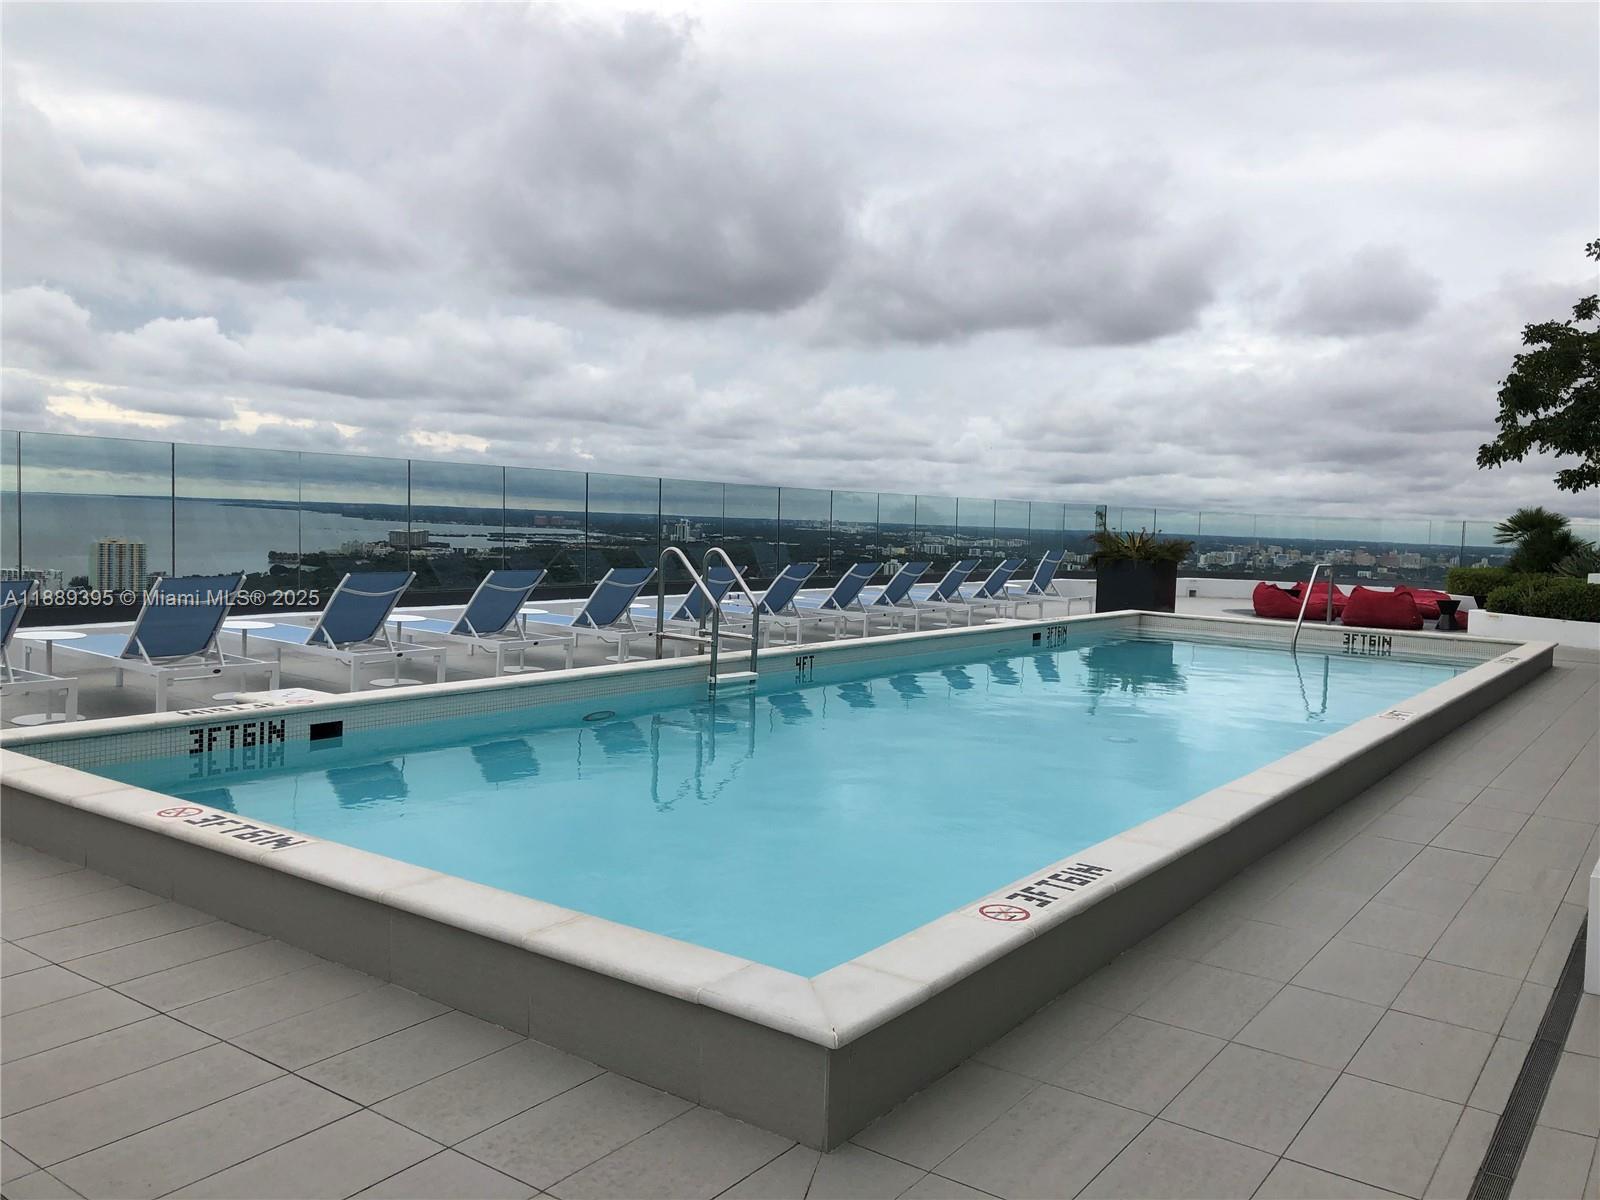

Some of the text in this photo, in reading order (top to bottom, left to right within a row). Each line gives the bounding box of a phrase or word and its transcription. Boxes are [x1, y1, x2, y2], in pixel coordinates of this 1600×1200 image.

[1343, 633, 1392, 648] 3FT6IN
[795, 655, 815, 671] 4FT
[189, 719, 286, 754] 3FT6IN
[184, 814, 307, 850] 3FT6IN
[1005, 862, 1112, 908] 3FT6IN
